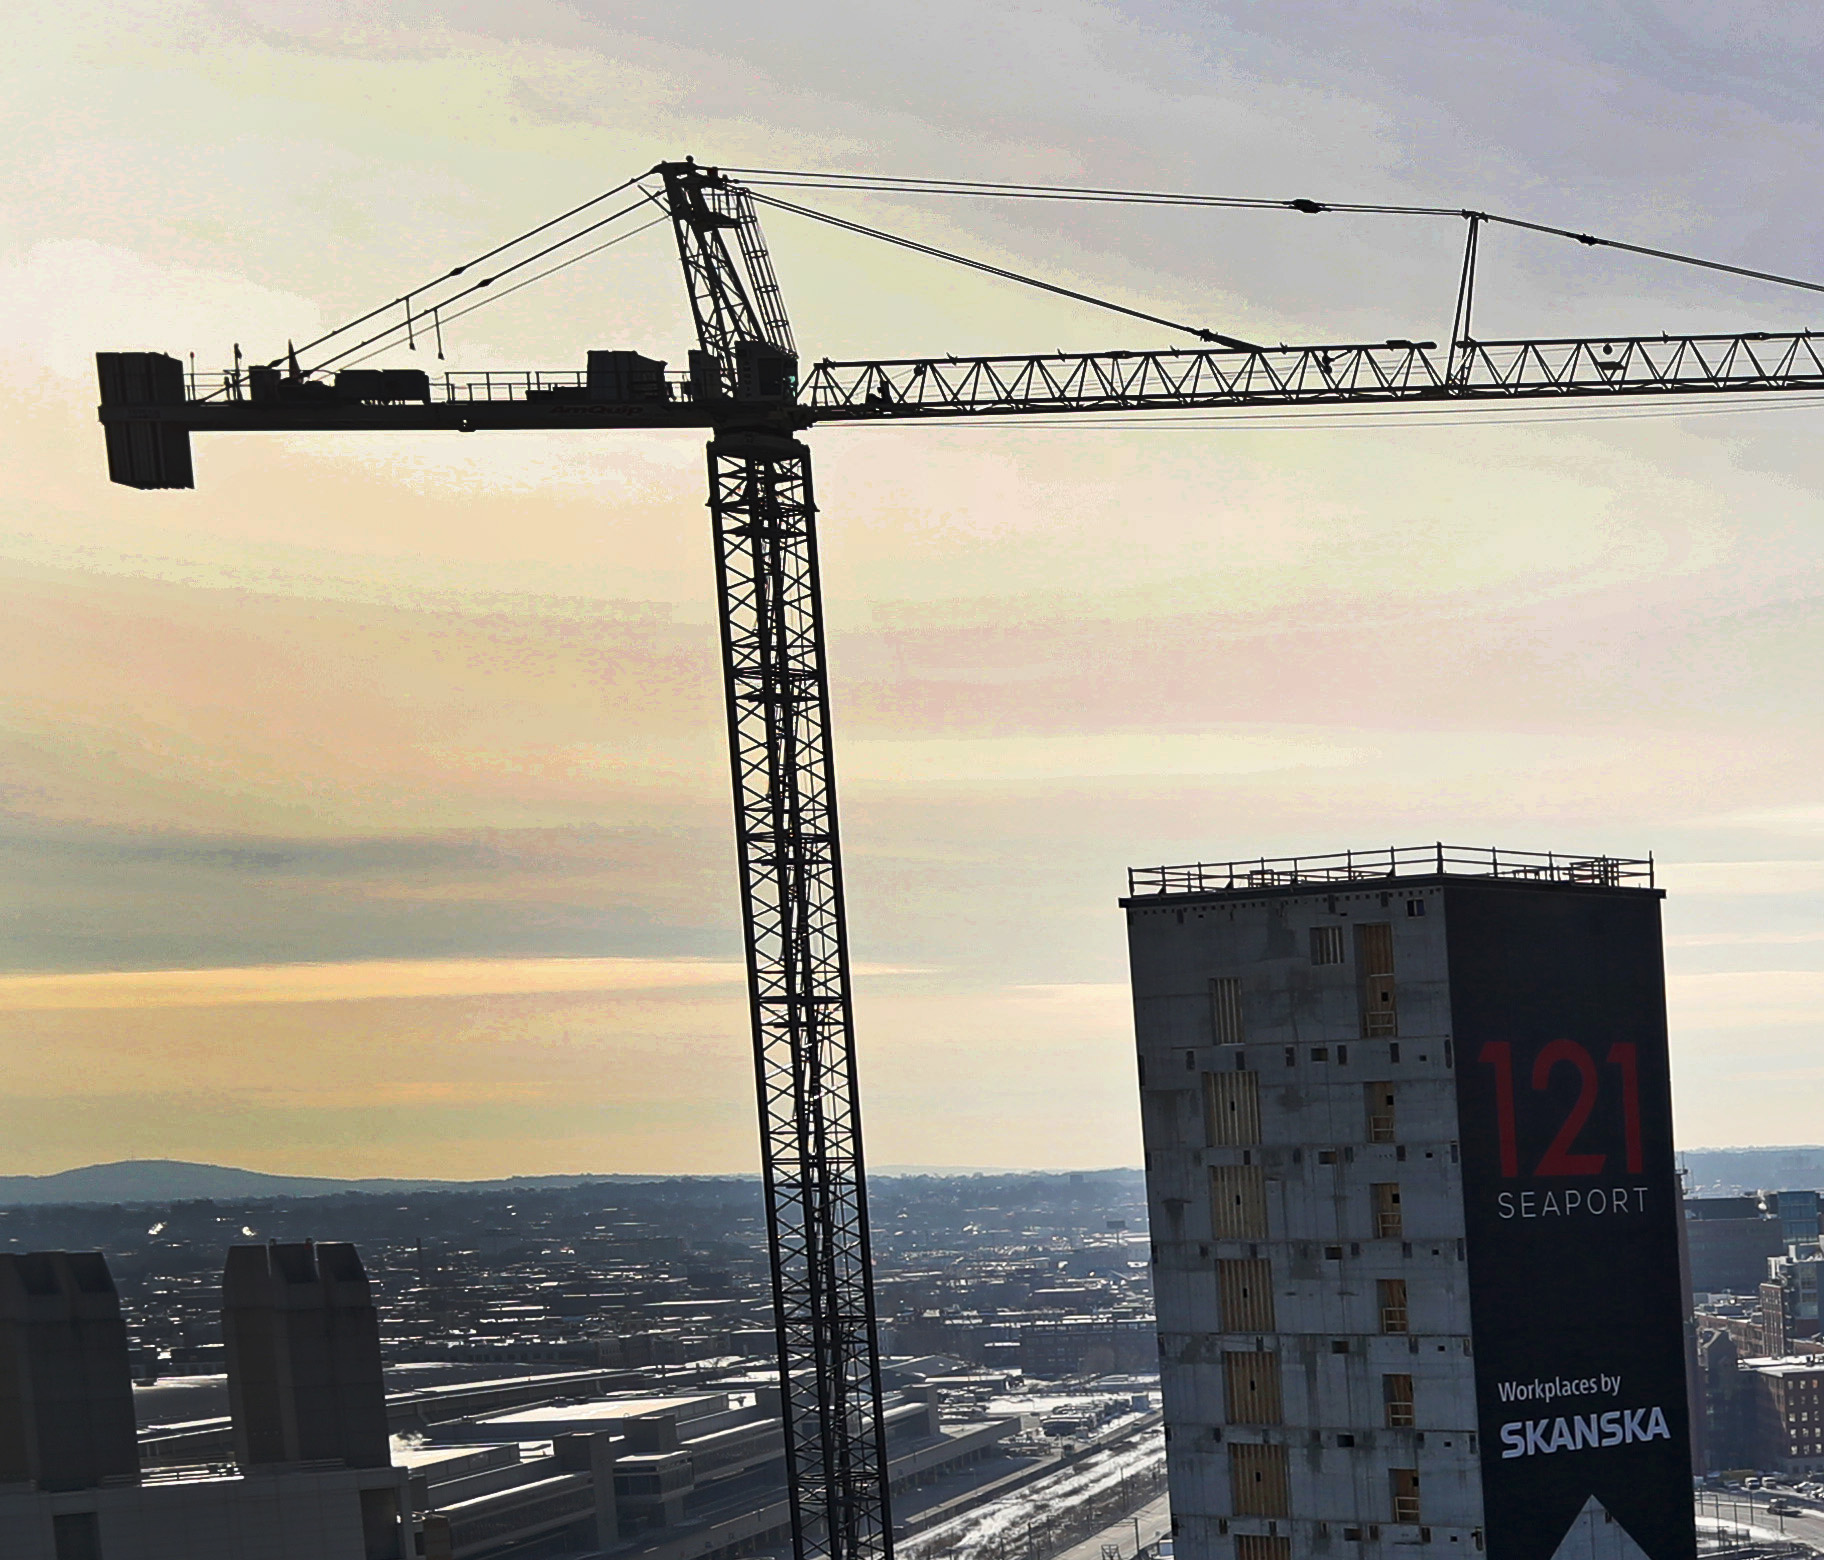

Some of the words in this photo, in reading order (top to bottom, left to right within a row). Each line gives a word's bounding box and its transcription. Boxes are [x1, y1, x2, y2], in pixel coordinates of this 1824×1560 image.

[1477, 1039, 1644, 1178] 121
[1498, 1186, 1649, 1219] SEAPORT
[1498, 1376, 1598, 1403] Workplaces
[1601, 1372, 1621, 1397] by
[1499, 1406, 1671, 1460] SKANSKA
